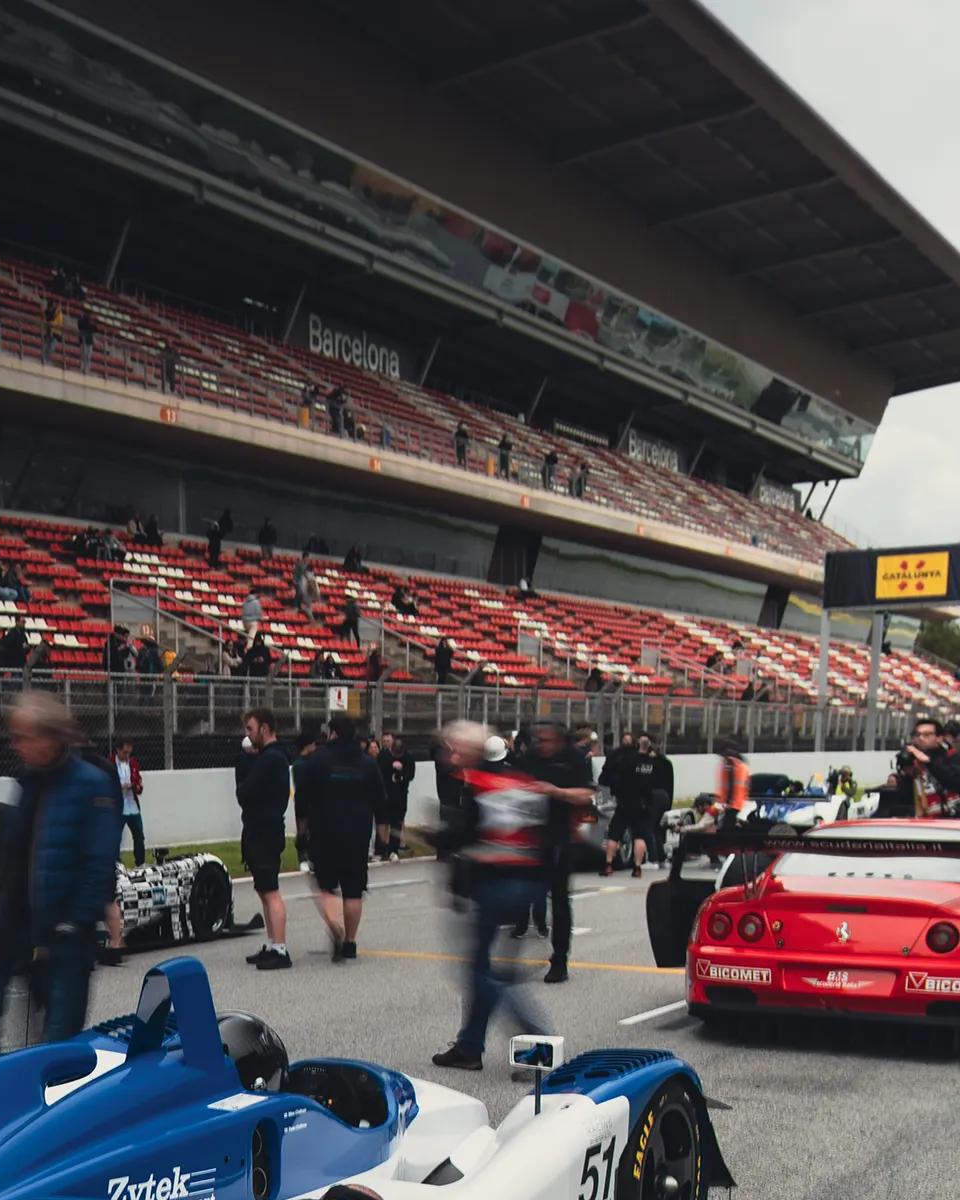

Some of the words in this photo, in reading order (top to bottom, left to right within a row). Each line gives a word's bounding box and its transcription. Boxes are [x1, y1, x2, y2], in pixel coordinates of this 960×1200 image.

[309, 311, 400, 378] Barcelona
[881, 570, 942, 581] CATALUNYA
[708, 965, 770, 982] BICOMET
[632, 1110, 655, 1181] EAGLE
